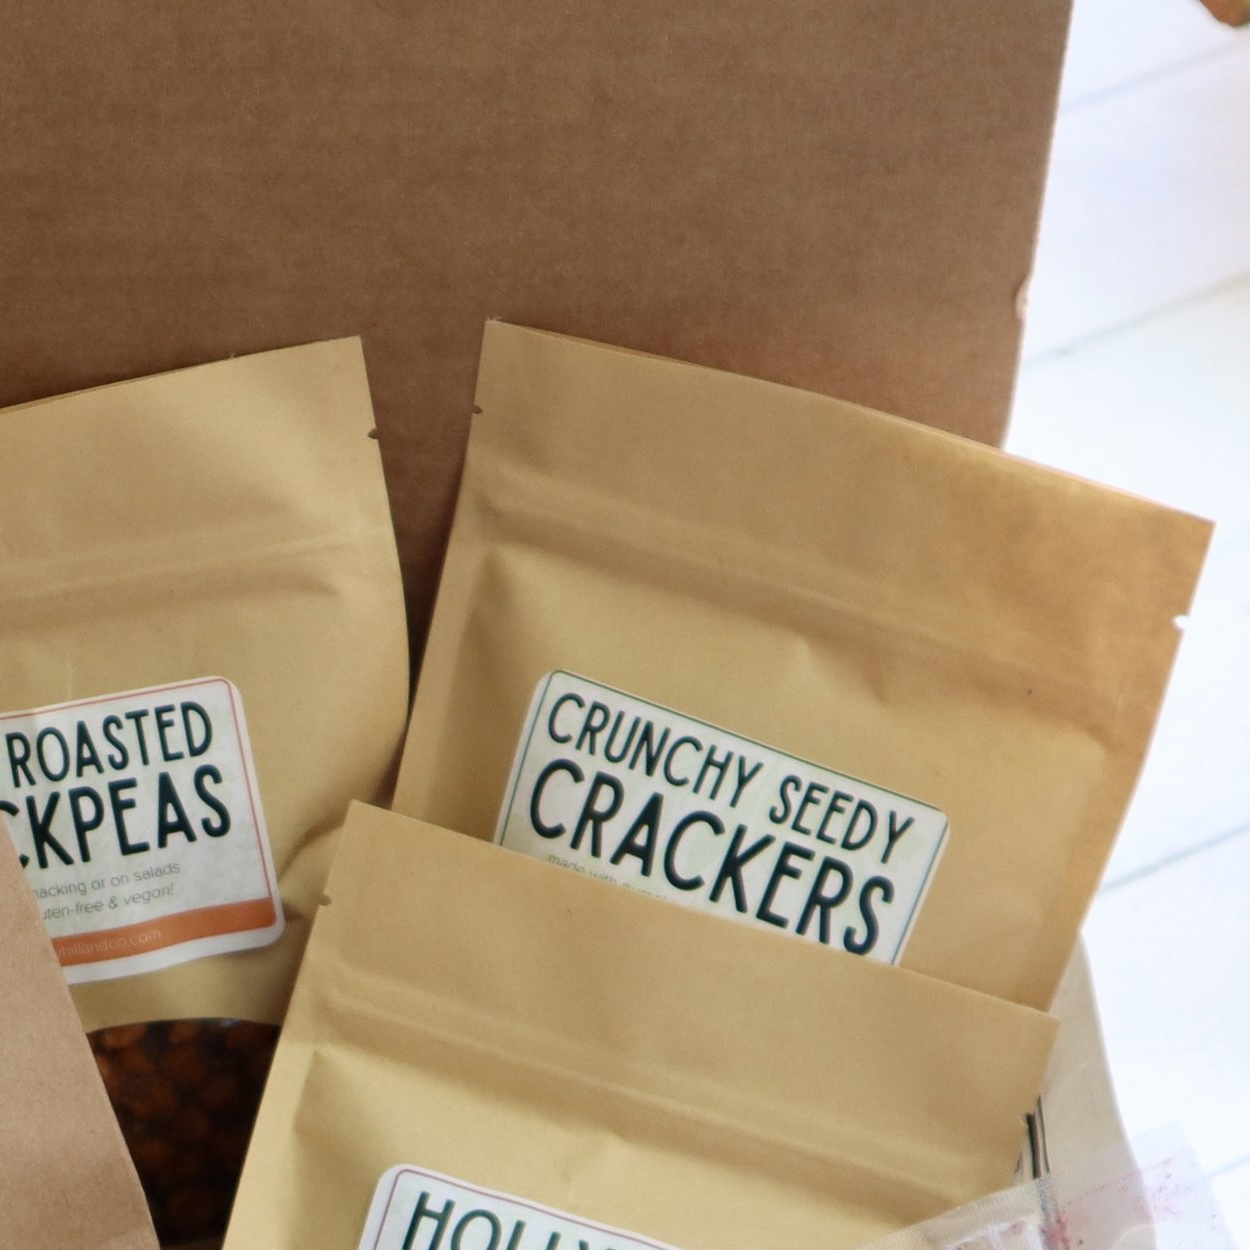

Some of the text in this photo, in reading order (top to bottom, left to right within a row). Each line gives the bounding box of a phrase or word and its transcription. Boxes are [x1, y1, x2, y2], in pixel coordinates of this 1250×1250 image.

[5, 701, 213, 788] ROASTED
[548, 692, 916, 864] CRUNCHY SEEDY
[91, 879, 107, 890] or
[111, 874, 129, 887] on
[134, 862, 181, 881] salads
[108, 896, 118, 909] &
[124, 883, 174, 904] vegan!
[529, 758, 895, 956] CRACKERS
